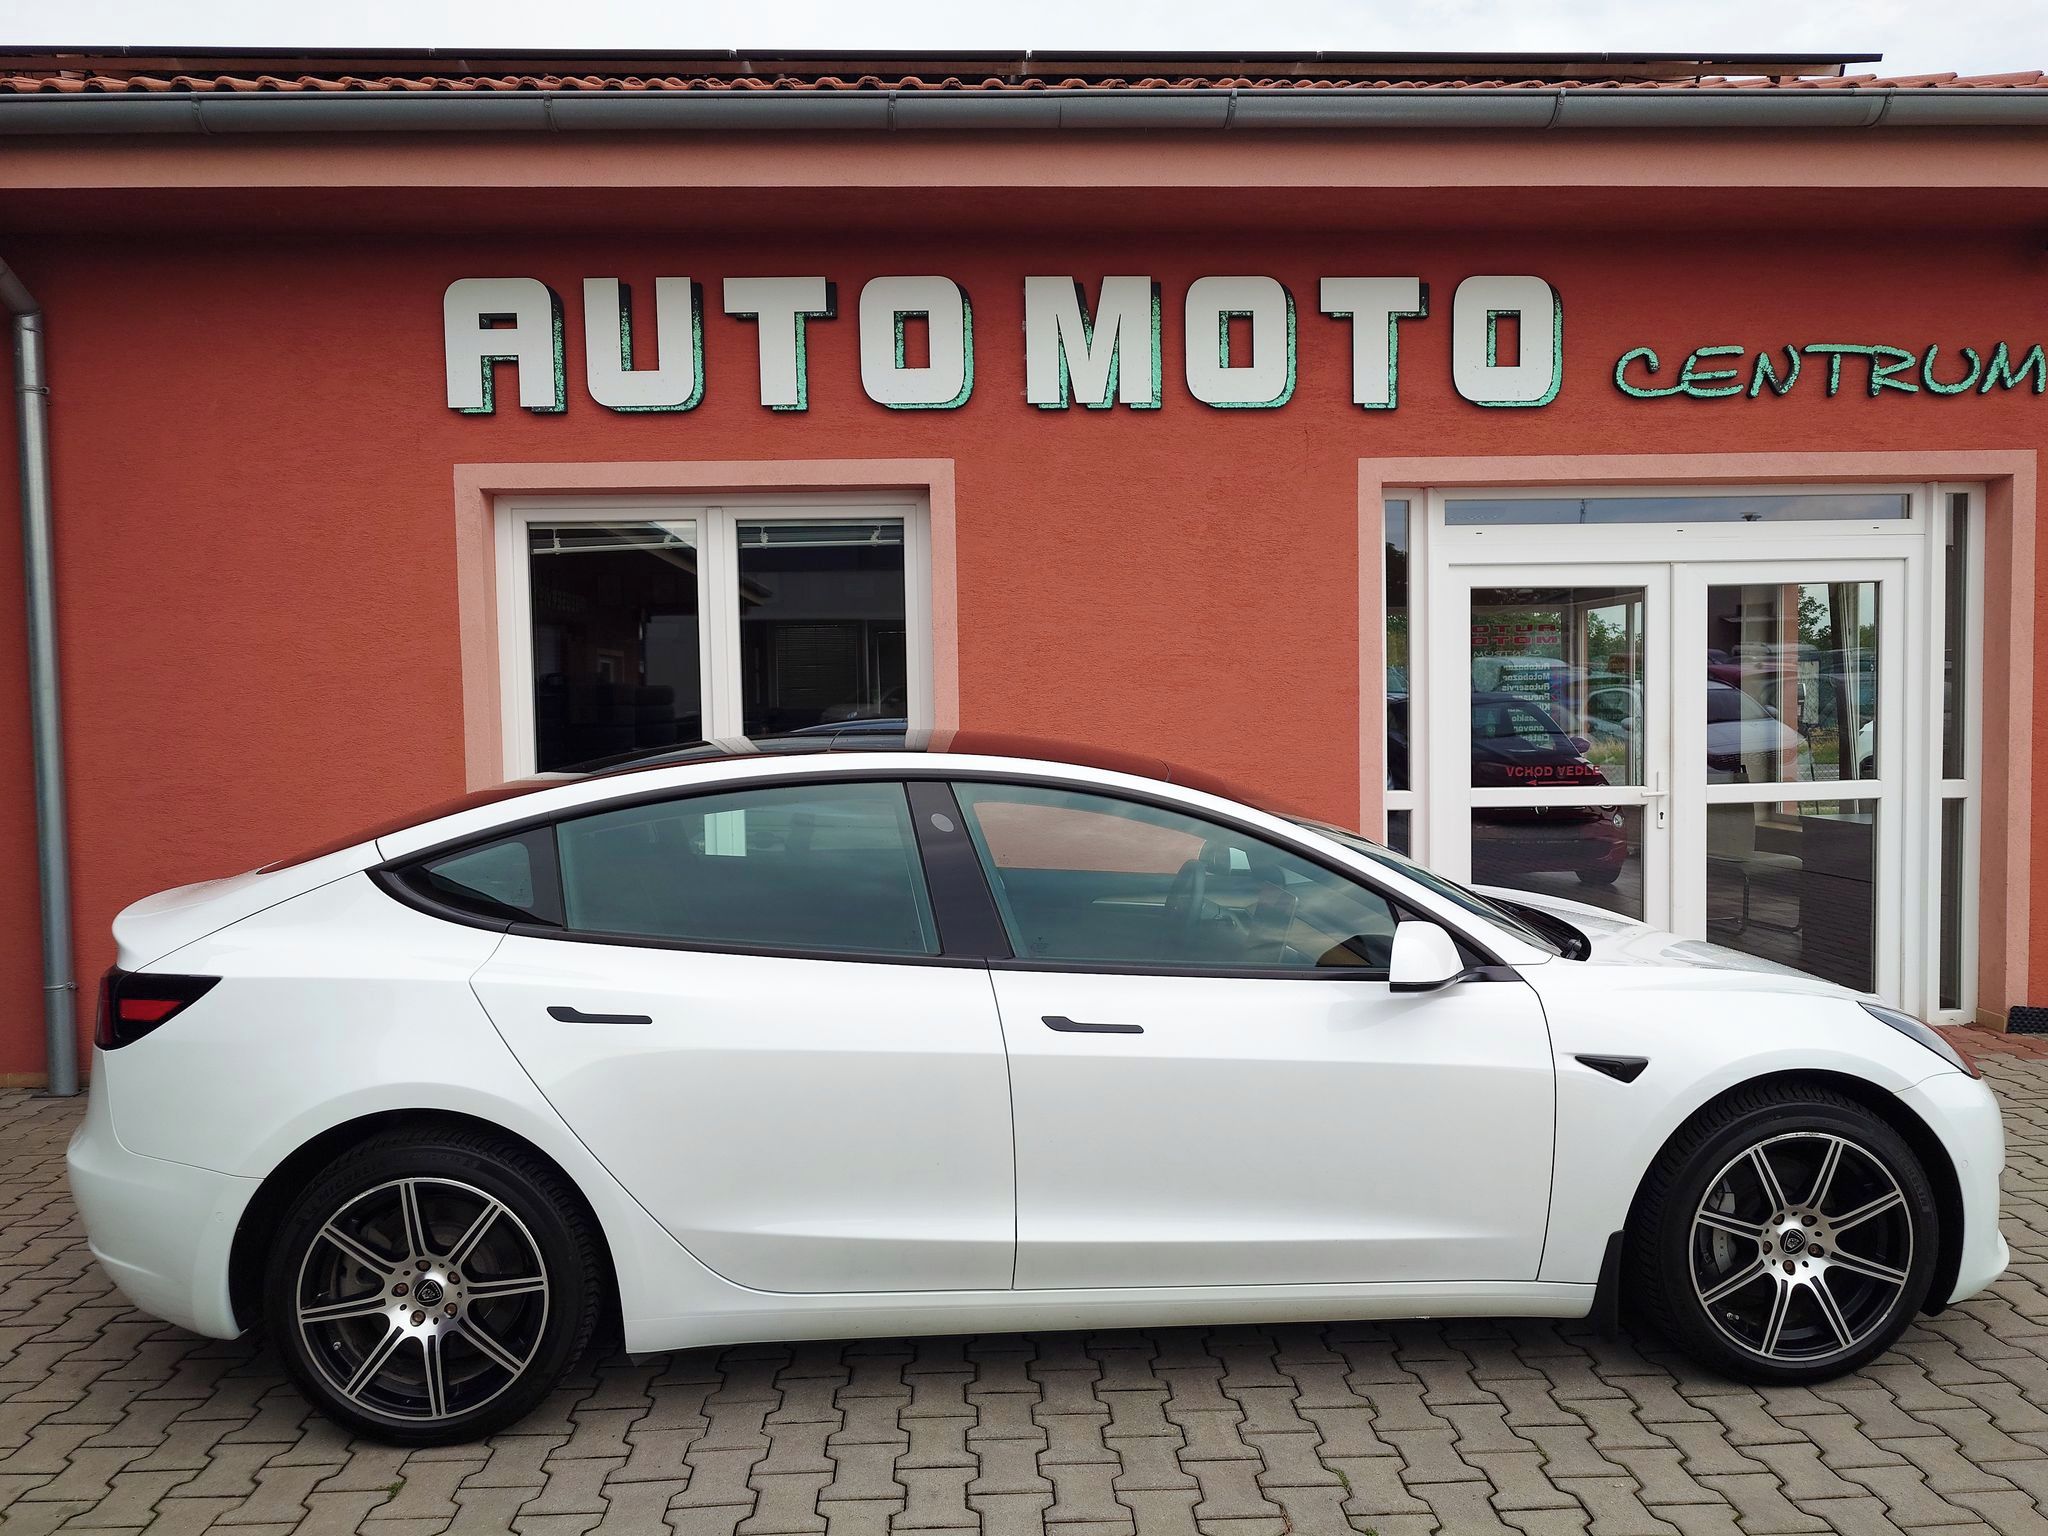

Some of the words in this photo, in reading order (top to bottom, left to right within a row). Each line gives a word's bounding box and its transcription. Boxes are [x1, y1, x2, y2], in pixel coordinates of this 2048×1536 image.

[443, 275, 975, 414] AUTO
[1023, 274, 1563, 411] MOTO
[1615, 341, 2047, 402] CENTRUM
[1505, 766, 1554, 777] VCHOD
[1557, 765, 1601, 776] VEDLE
